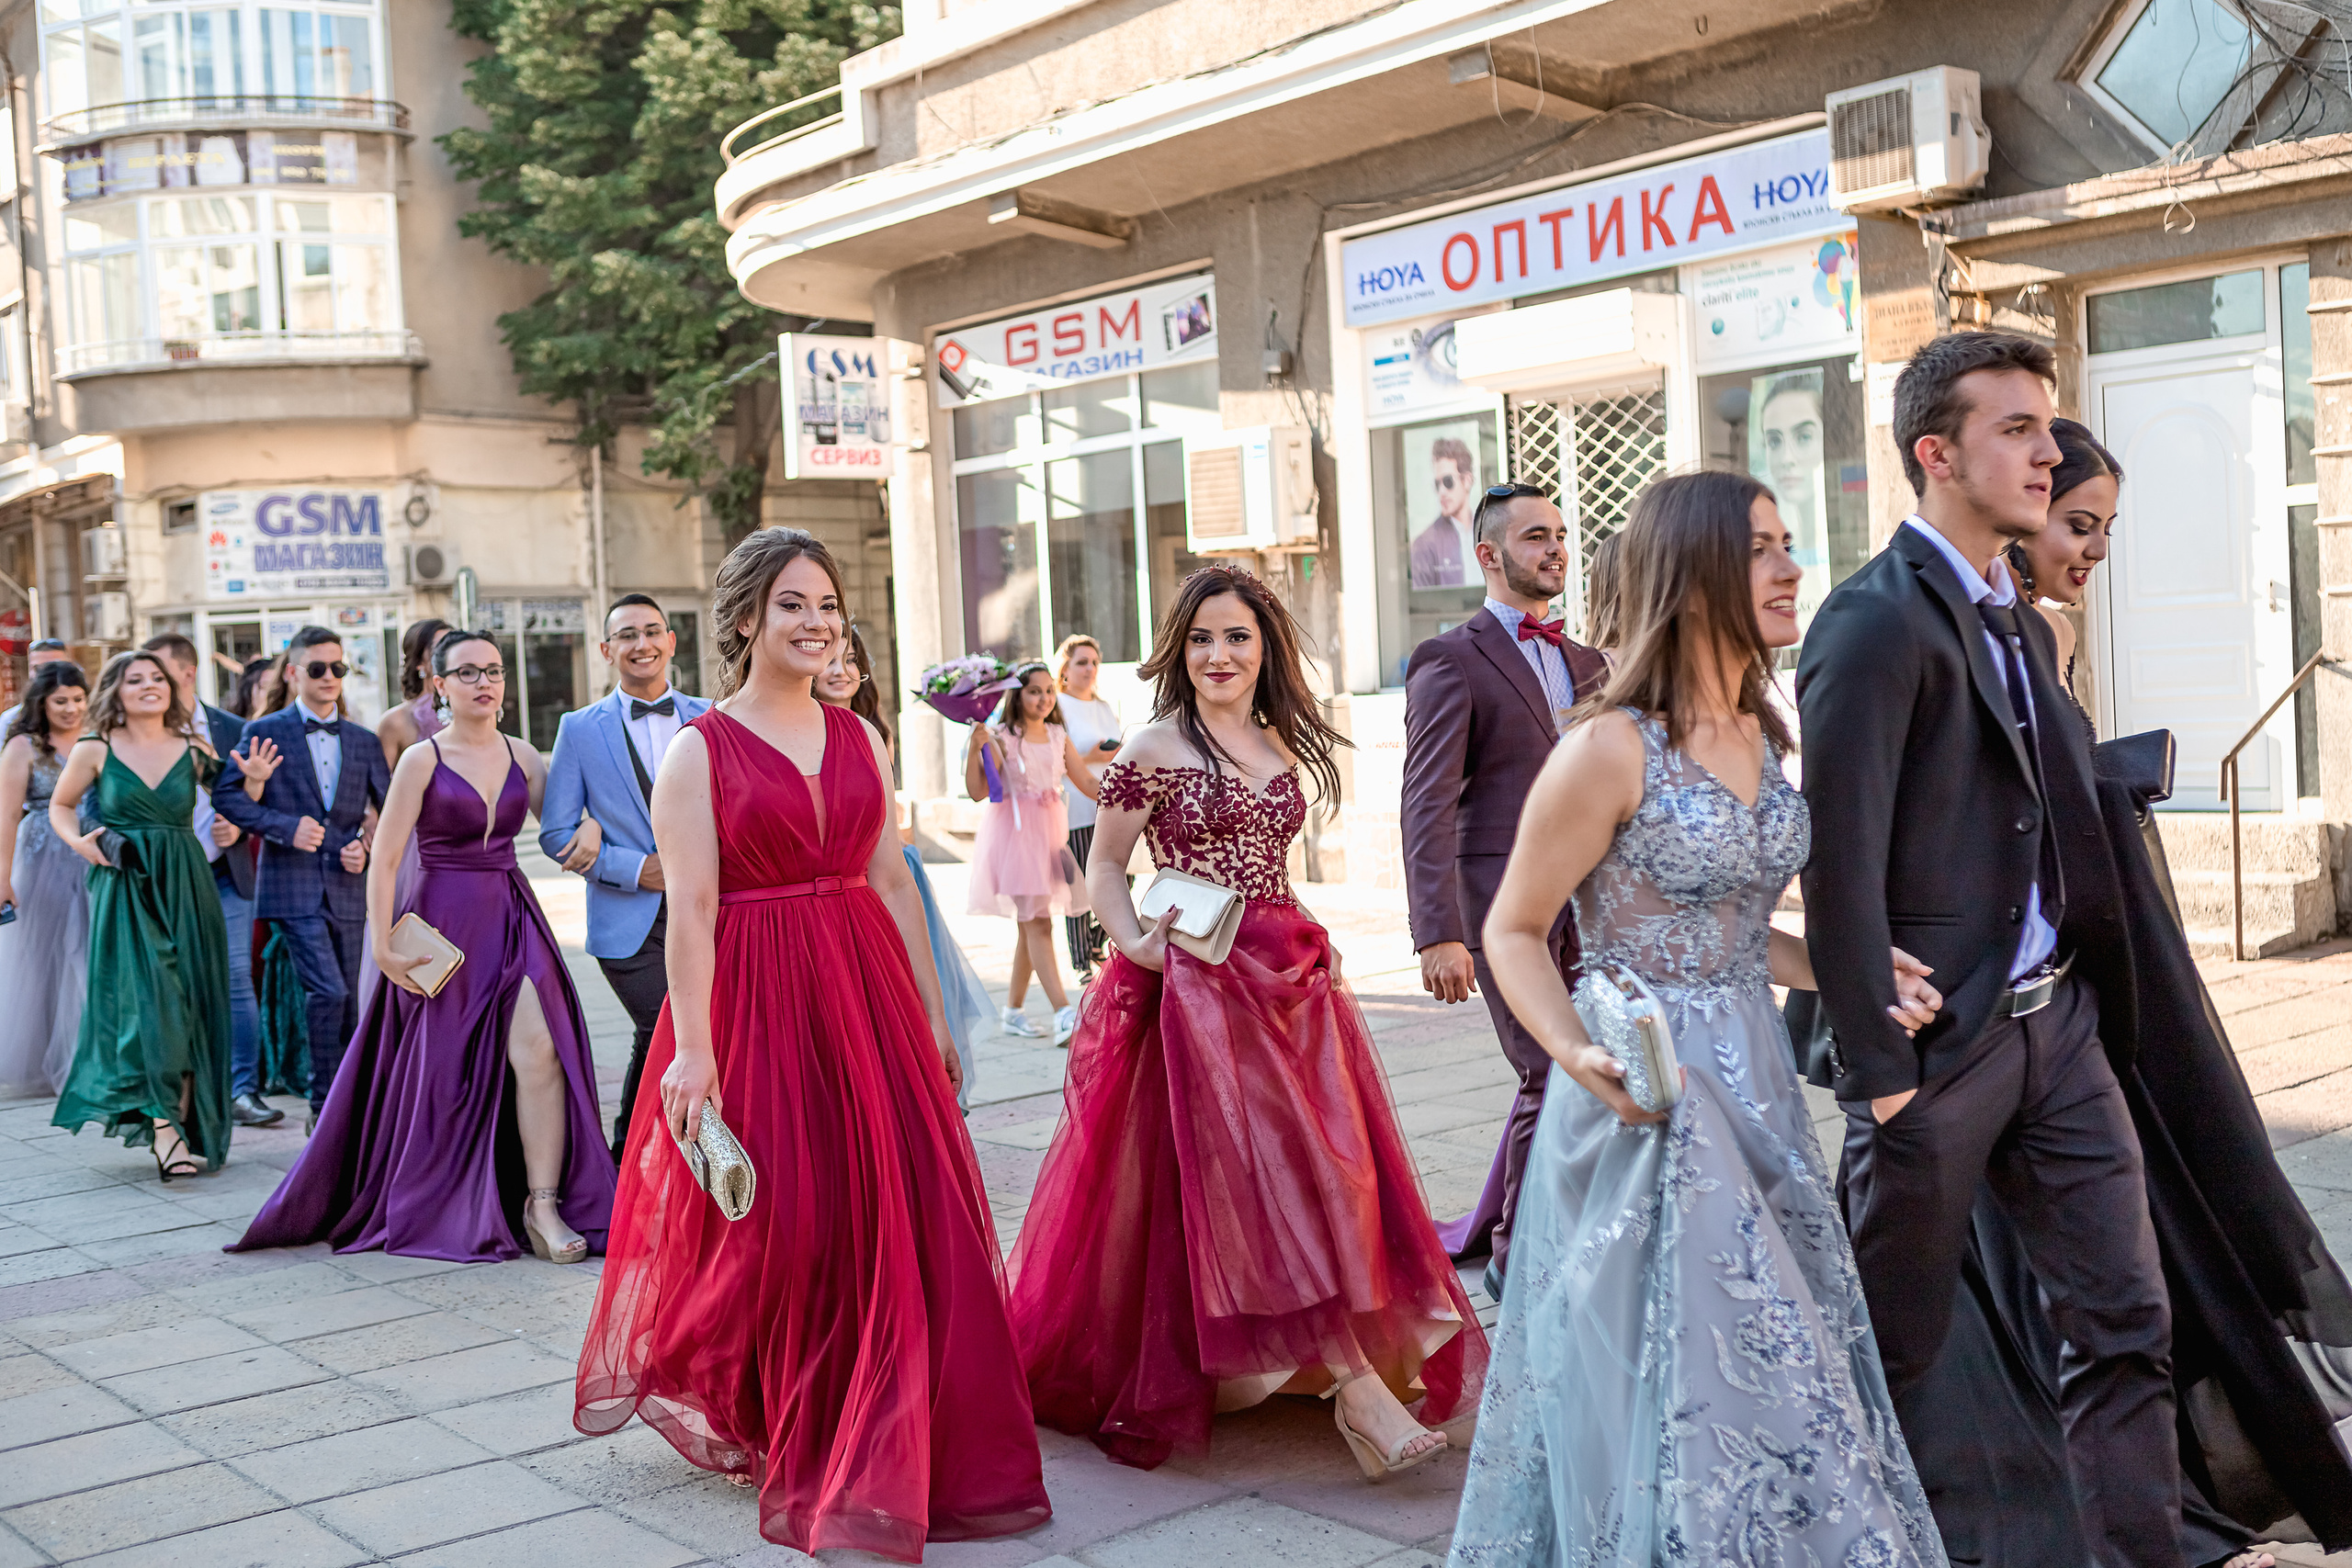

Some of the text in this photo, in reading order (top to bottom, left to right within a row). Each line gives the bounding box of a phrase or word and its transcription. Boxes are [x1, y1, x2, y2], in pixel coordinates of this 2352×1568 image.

[1442, 174, 1736, 292] ОПТИКА
[1360, 261, 1425, 296] HOYA
[1005, 298, 1141, 367] GSM
[807, 347, 878, 378] GSM
[1023, 348, 1144, 381] АГАЗИН
[798, 404, 889, 422] МАГАЗИН
[810, 448, 882, 466] СЕРВИЗ
[256, 494, 381, 536] GSM
[254, 543, 384, 571] МАГАЗИН
